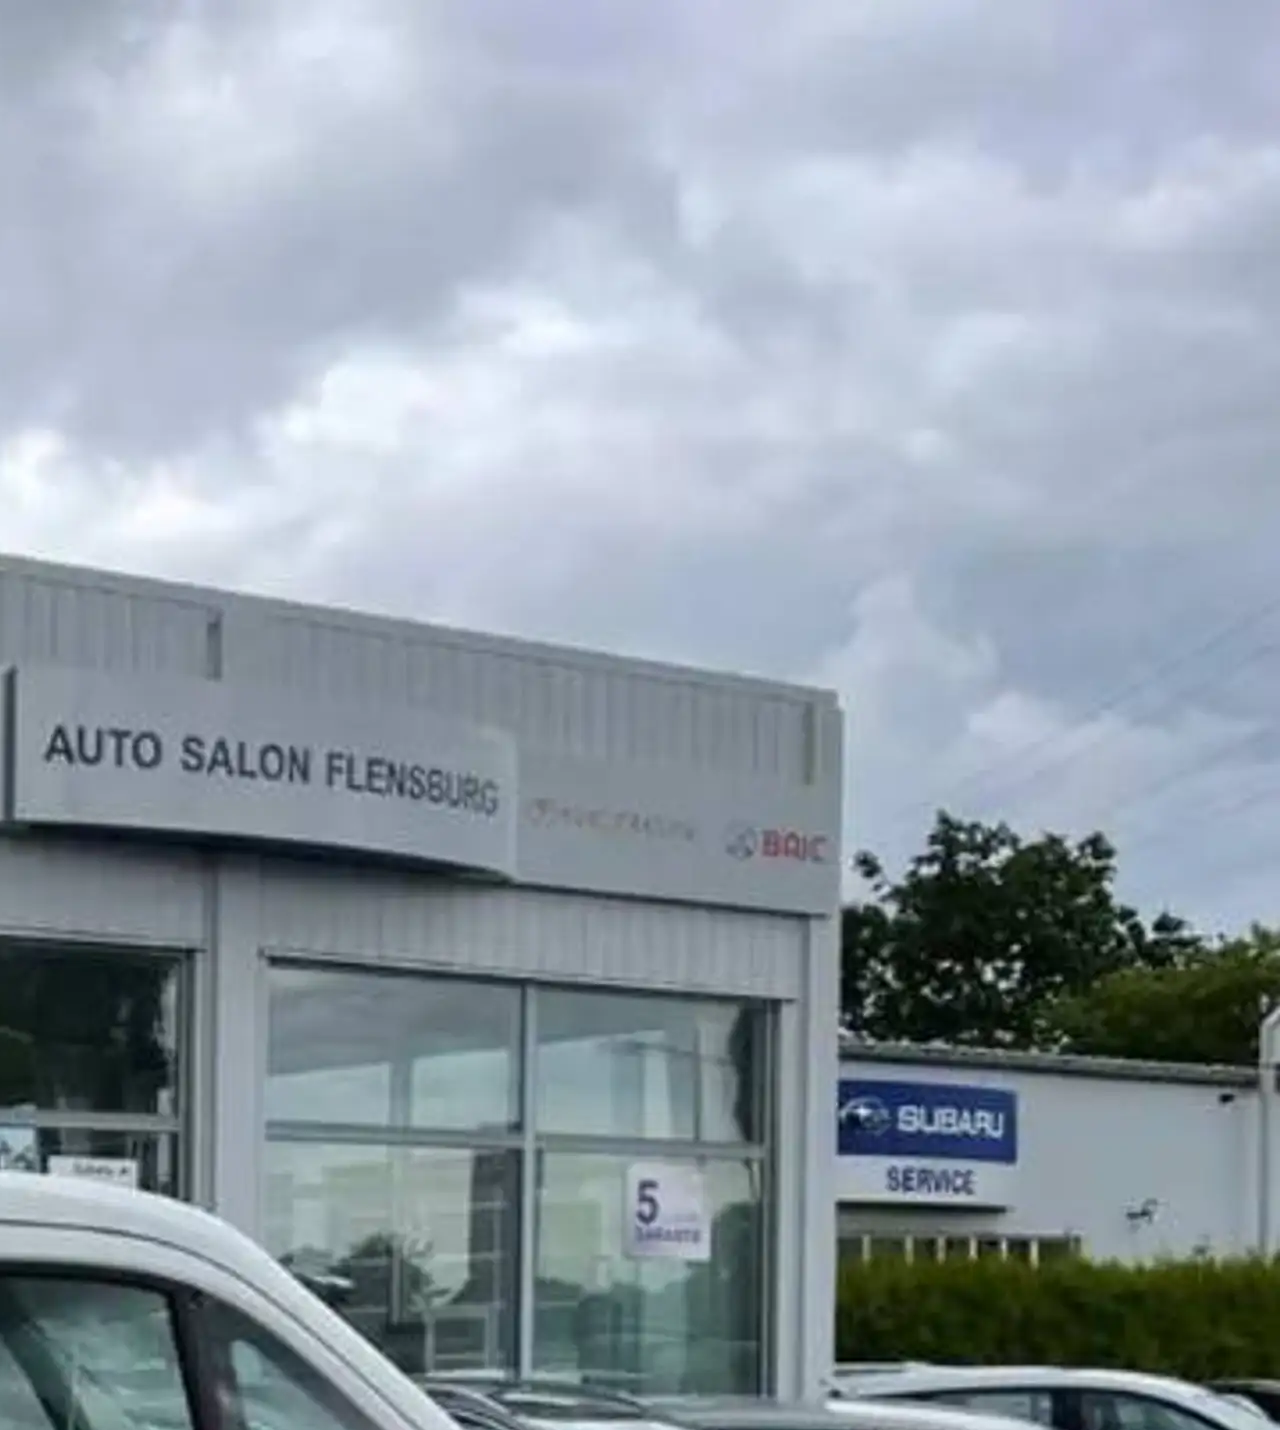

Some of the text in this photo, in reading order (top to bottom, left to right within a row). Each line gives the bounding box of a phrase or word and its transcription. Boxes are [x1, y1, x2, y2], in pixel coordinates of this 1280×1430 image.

[44, 725, 500, 816] AUTO SALON FLENSBURG
[761, 829, 828, 862] BAIC
[897, 1104, 1004, 1138] SUBARU
[886, 1165, 977, 1196] SERVICE
[636, 1179, 659, 1225] 5
